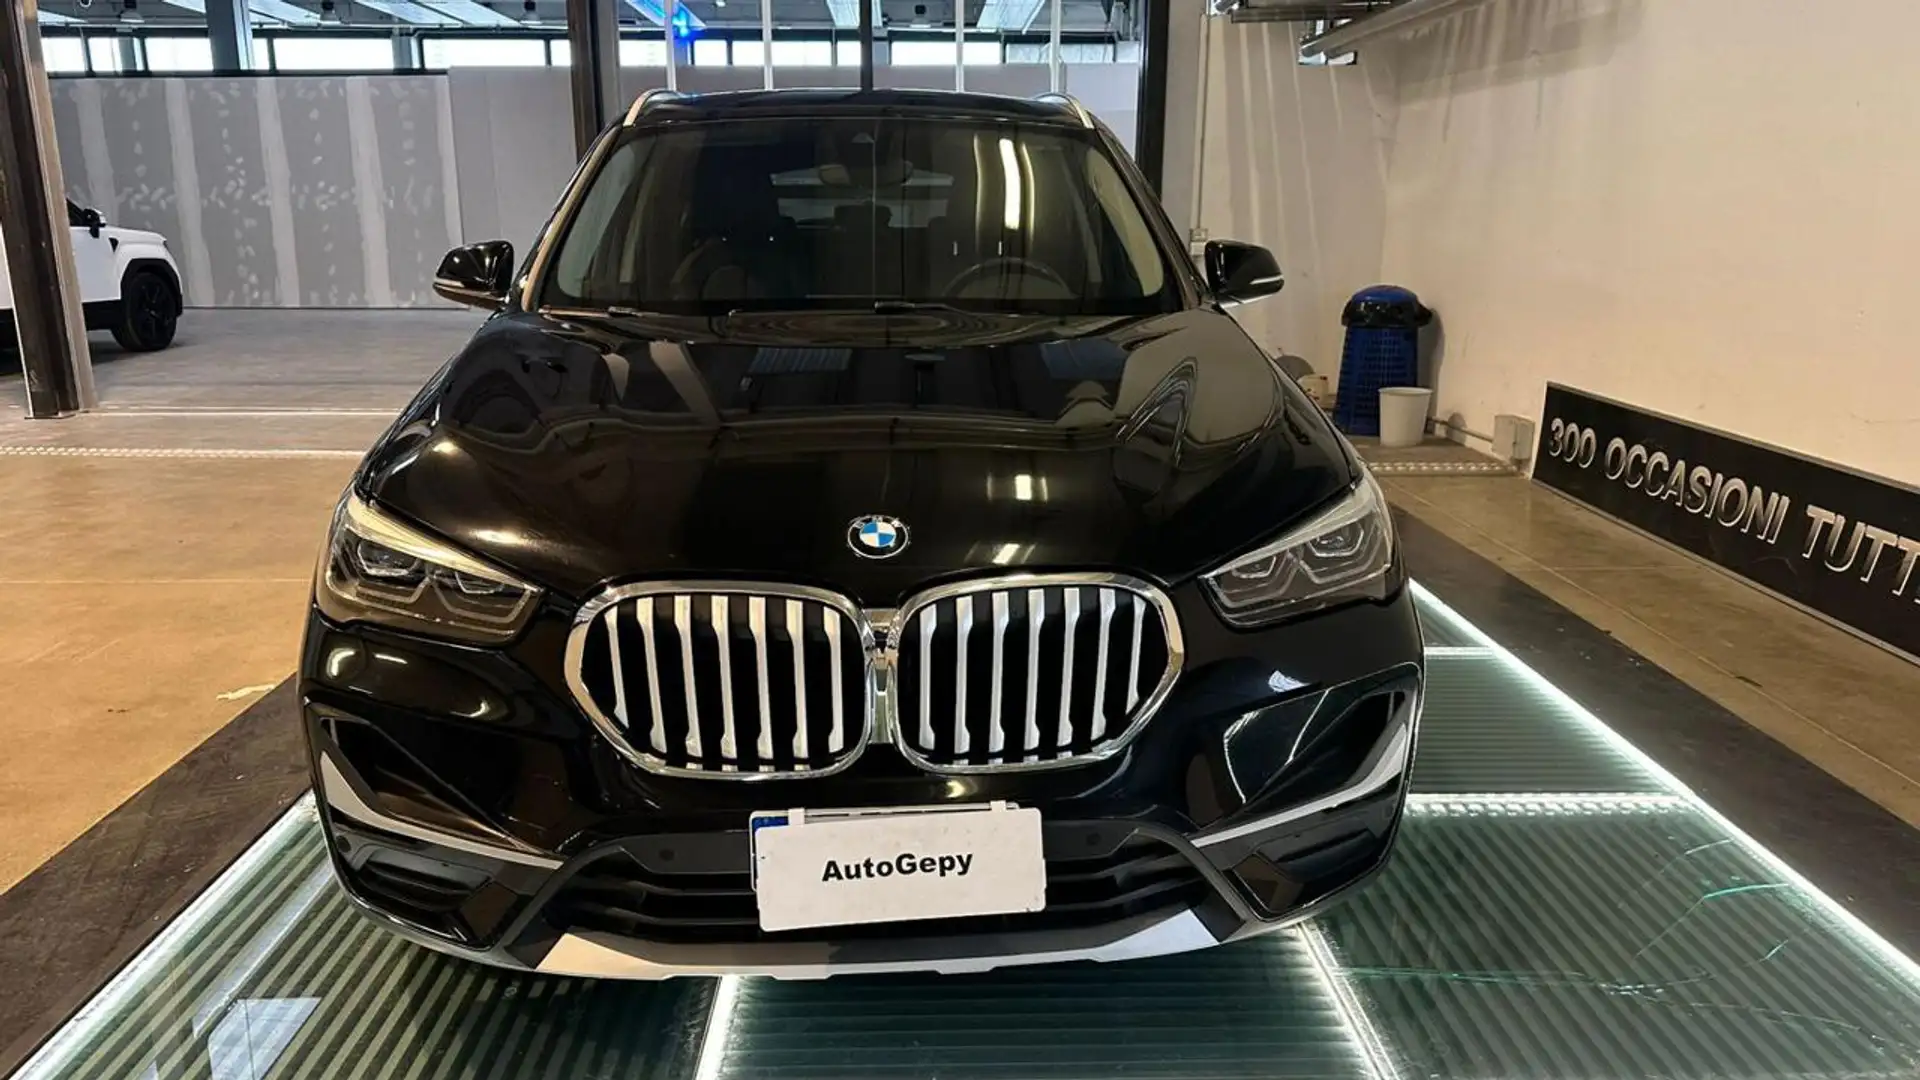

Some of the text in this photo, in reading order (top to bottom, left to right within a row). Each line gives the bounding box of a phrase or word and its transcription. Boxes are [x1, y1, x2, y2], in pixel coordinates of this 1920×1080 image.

[1549, 418, 1920, 604] 300 OCCASIONI TUTT
[822, 853, 973, 882] AutoGepy
